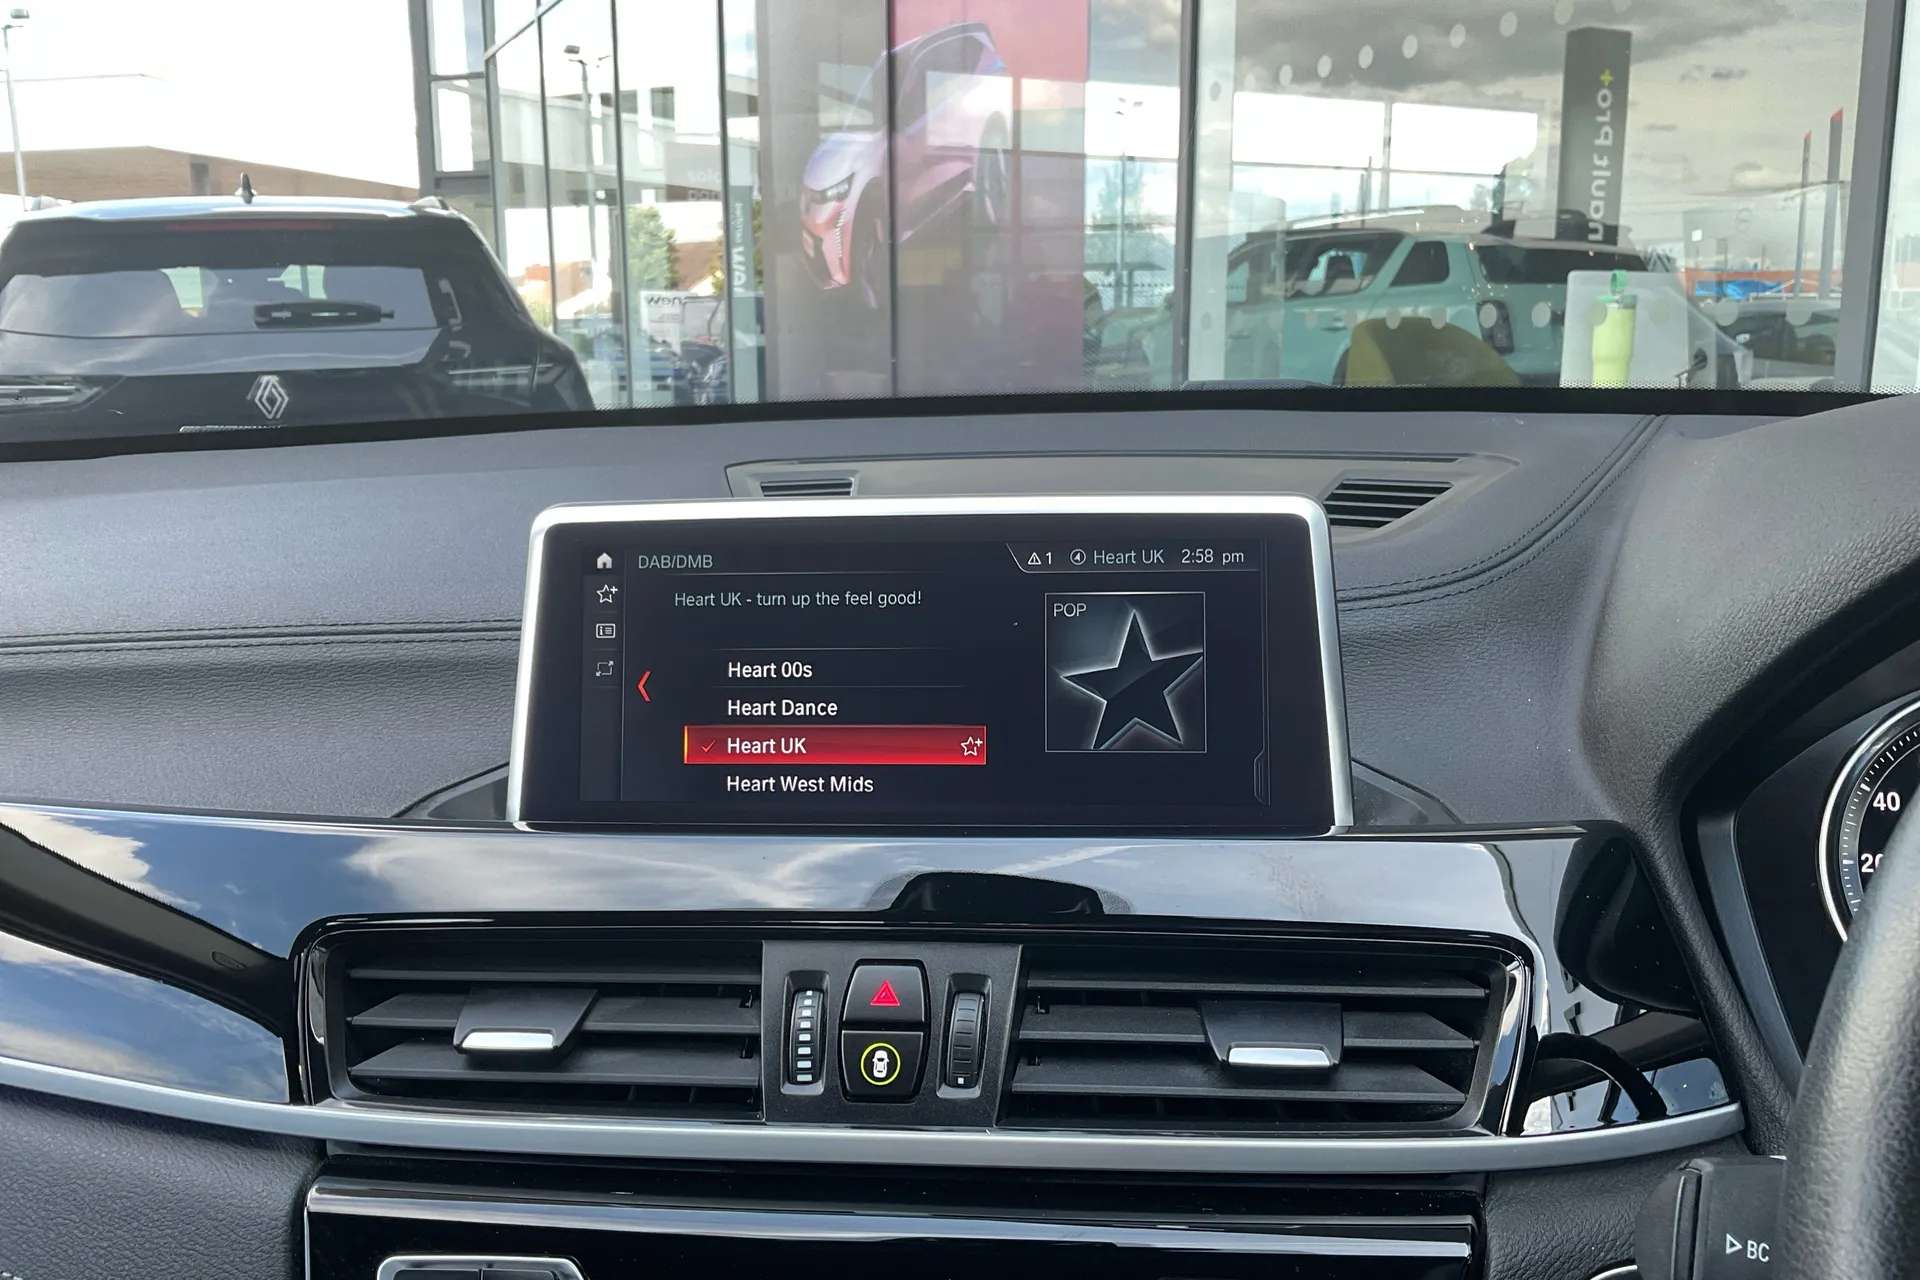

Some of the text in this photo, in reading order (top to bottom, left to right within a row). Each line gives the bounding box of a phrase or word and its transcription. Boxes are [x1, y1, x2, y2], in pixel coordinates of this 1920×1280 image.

[637, 554, 713, 570] DAB/DMB
[1045, 552, 1052, 565] 1
[1093, 549, 1165, 564] Heart UK
[1181, 548, 1244, 566] 2:58 pm
[674, 592, 715, 607] Heart
[720, 592, 742, 606] UK
[756, 592, 786, 606] turn
[791, 594, 811, 608] up
[815, 591, 840, 606] the
[845, 591, 873, 605] feel
[877, 590, 922, 608] good!
[1053, 602, 1087, 618] POP
[727, 661, 813, 678] Heart 00s
[727, 699, 838, 716] Heart Dance
[727, 737, 807, 754] Heart UK
[727, 775, 874, 792] Heart West Mids
[1872, 791, 1901, 812] 40
[1747, 1239, 1770, 1263] BC
